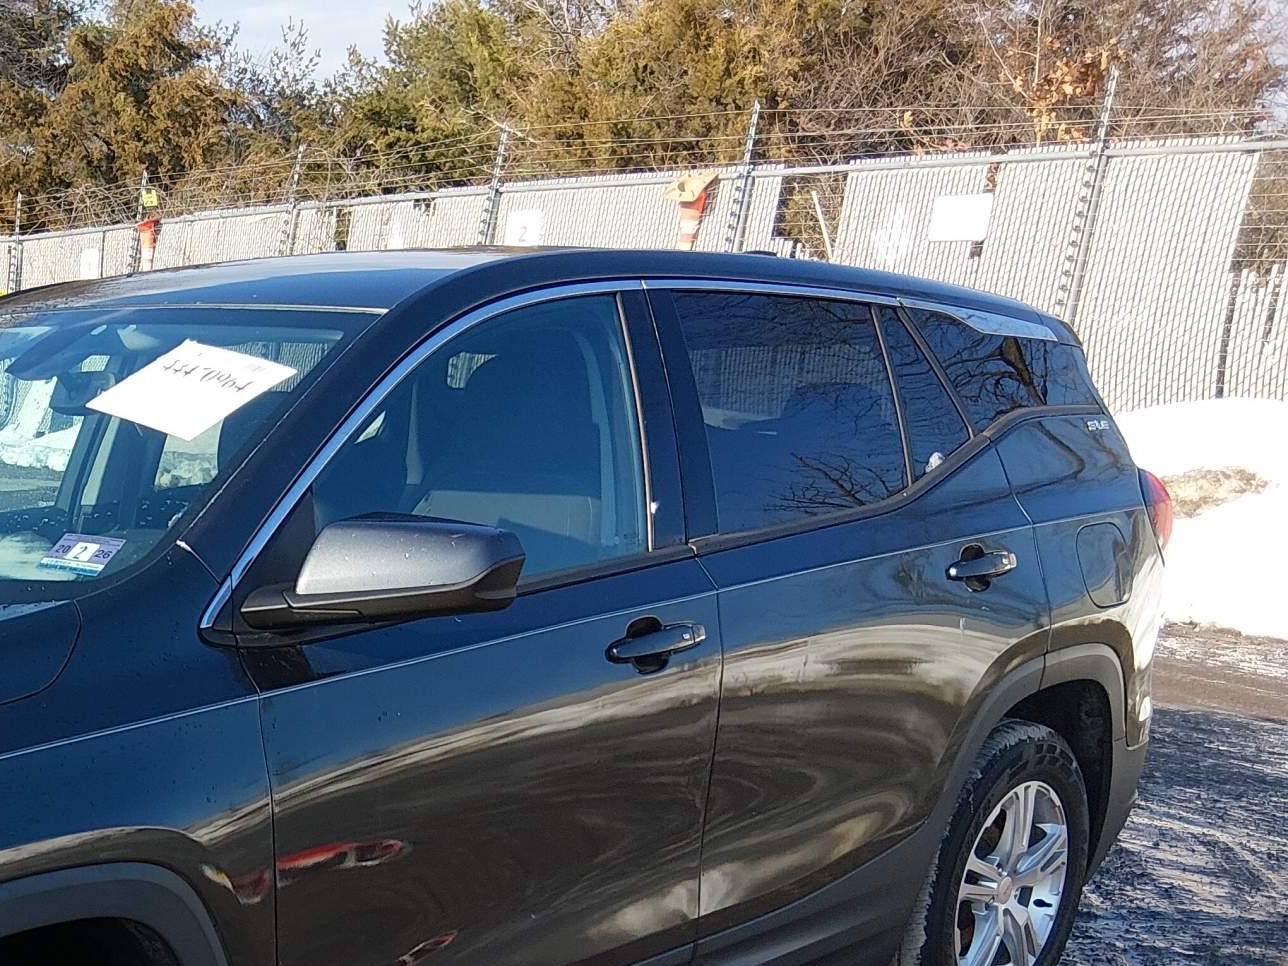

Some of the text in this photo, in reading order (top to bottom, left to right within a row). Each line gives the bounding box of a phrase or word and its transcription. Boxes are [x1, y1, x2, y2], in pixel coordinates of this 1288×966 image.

[55, 544, 113, 560] 20 2 26
